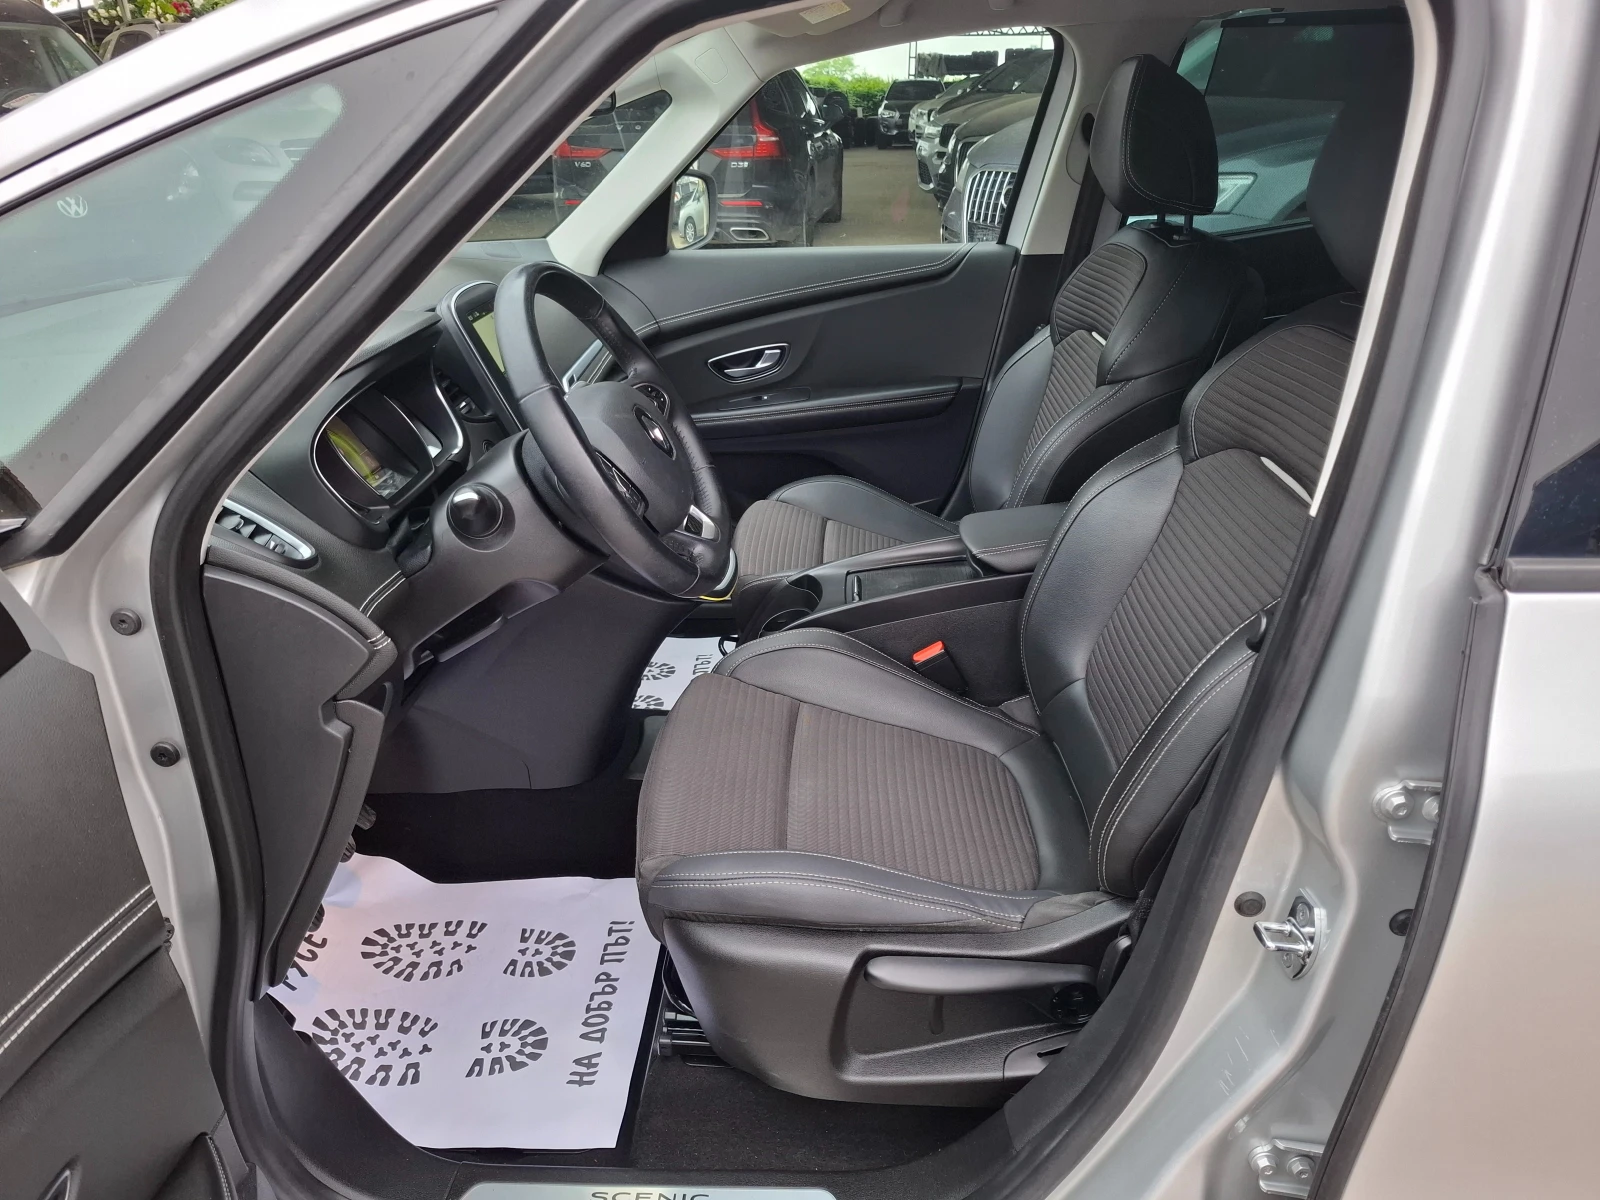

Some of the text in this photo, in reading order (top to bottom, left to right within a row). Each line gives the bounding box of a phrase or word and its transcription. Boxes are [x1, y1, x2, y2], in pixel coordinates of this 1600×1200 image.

[565, 920, 636, 1088] НА ДОБЪР ПЪТ!
